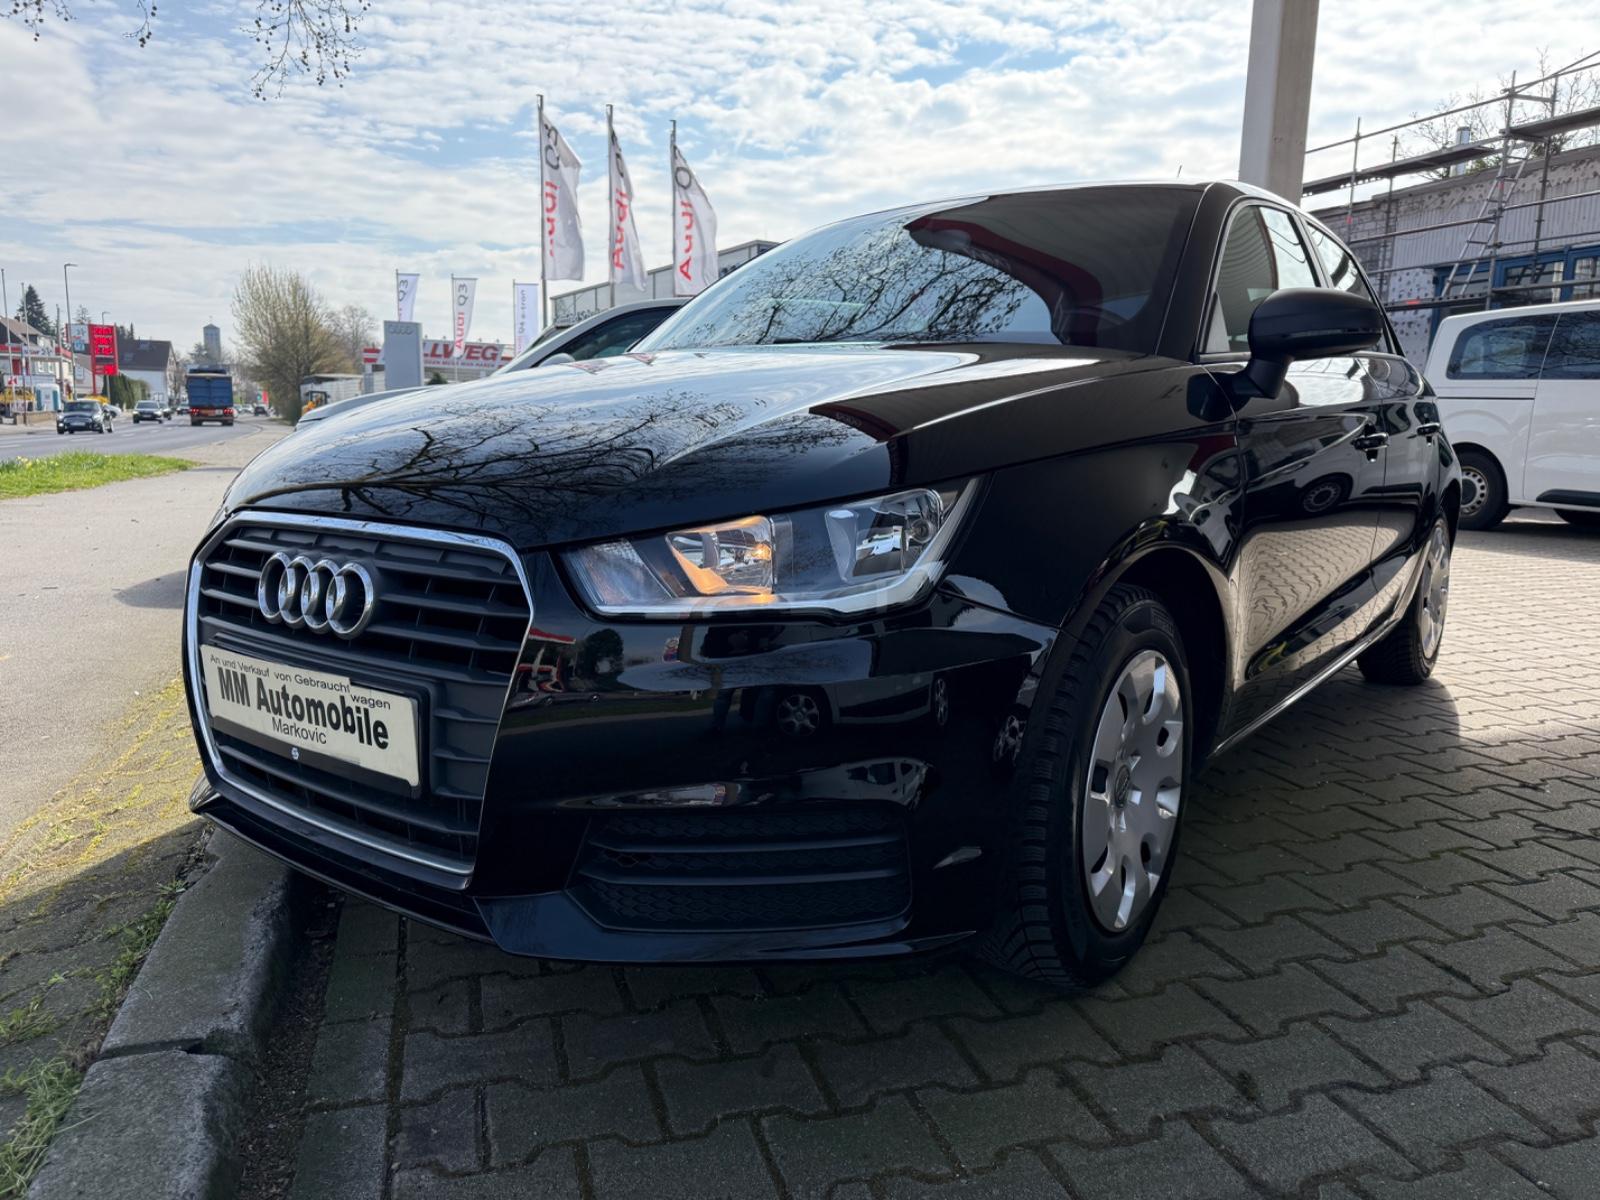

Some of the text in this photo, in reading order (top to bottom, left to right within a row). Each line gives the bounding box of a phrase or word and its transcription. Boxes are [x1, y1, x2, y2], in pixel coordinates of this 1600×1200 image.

[679, 200, 694, 281] Audi
[454, 283, 468, 349] Audi Q3
[423, 342, 499, 361] LWEG
[210, 654, 221, 664] An
[221, 658, 236, 669] und
[237, 661, 270, 678] Verkauf
[274, 672, 292, 683] von
[350, 694, 391, 710] wagen
[217, 666, 389, 749] MM Automobile
[272, 716, 327, 745] Markovic
